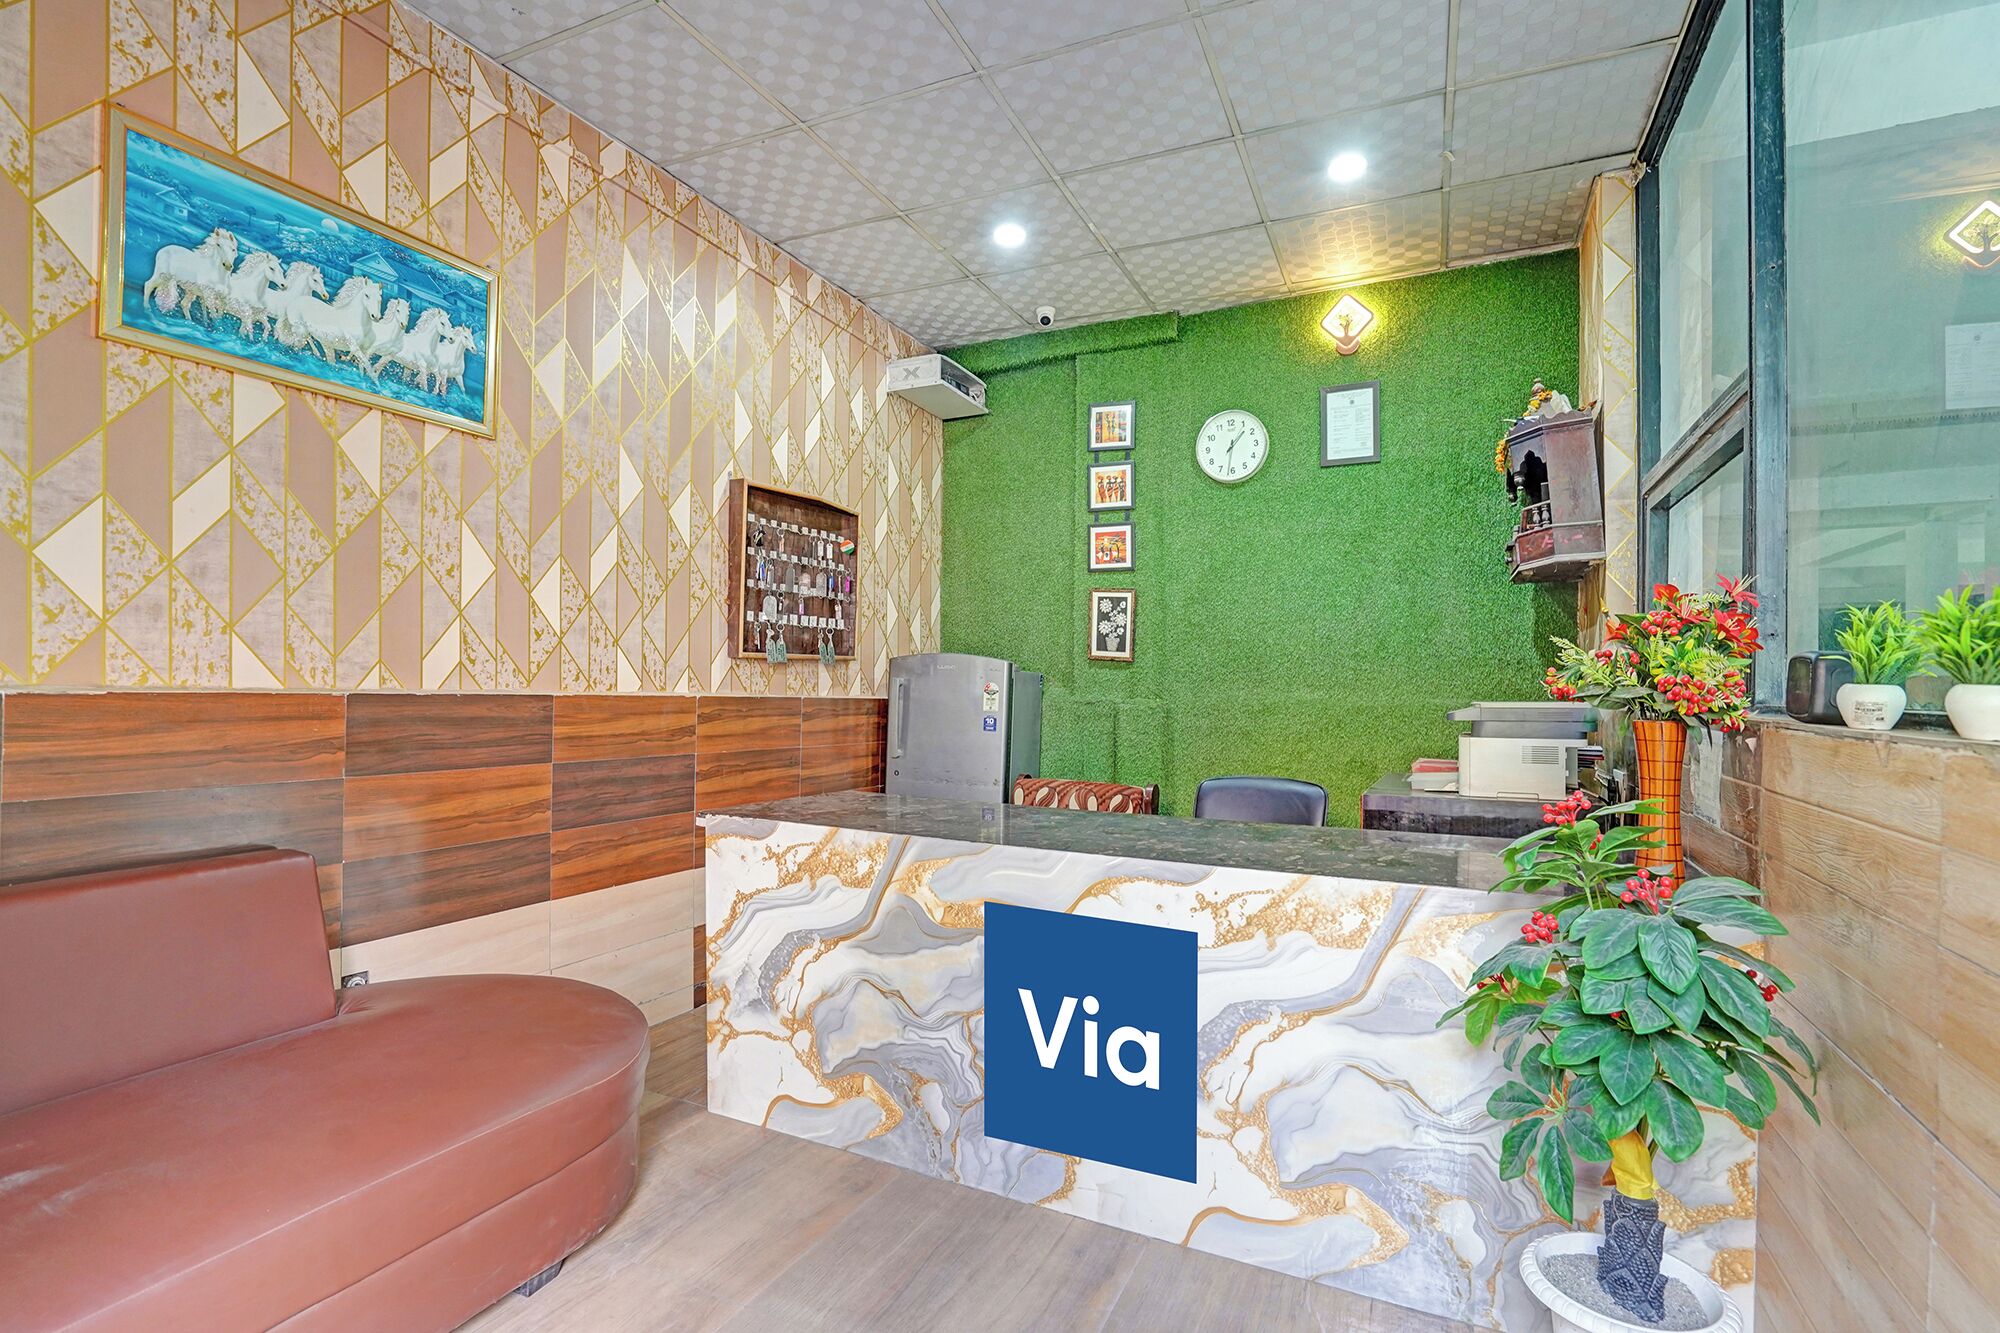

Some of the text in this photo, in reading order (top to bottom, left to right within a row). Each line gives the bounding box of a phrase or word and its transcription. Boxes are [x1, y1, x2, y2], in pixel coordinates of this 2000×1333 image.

[1227, 419, 1235, 427] 12
[1207, 434, 1216, 442] 10
[1253, 439, 1259, 447] 3
[1205, 446, 1211, 454] 9
[1218, 465, 1223, 473] 7
[1017, 987, 1160, 1091] Via
